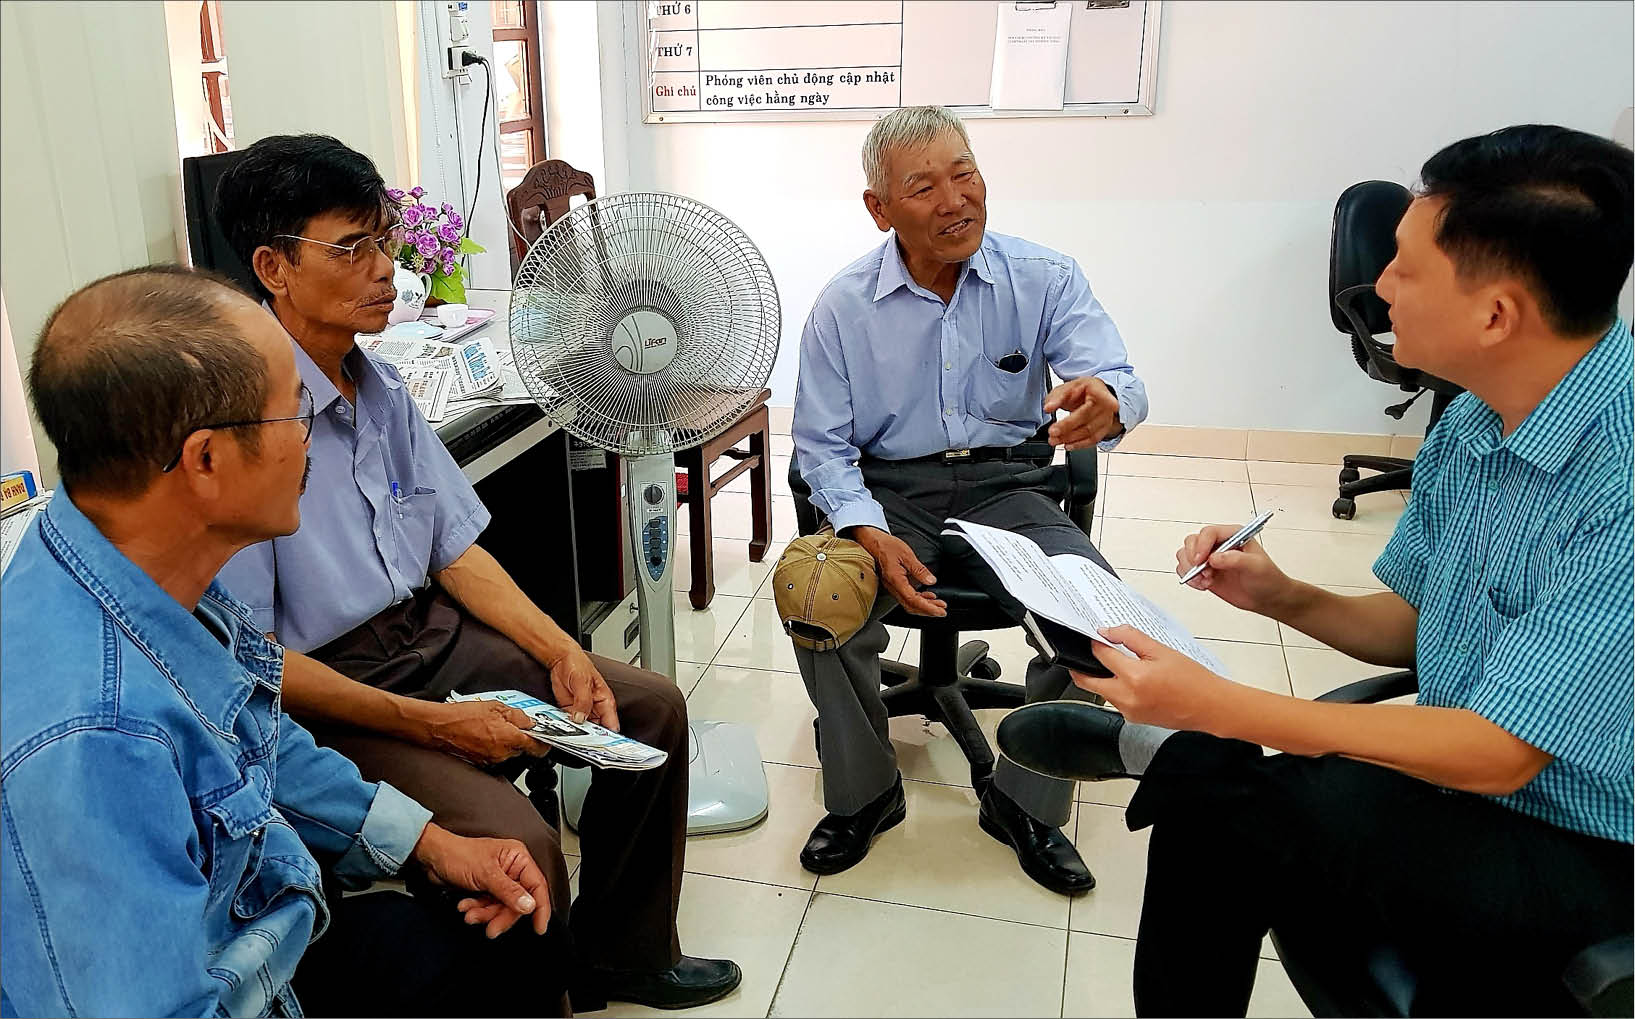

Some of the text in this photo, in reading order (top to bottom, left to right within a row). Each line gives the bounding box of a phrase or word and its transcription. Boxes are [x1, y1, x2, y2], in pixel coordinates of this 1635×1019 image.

[684, 4, 691, 15] 6
[656, 42, 693, 57] THỨ 7
[705, 74, 744, 89] Phóng
[747, 75, 773, 86] viên
[777, 73, 799, 85] chủ
[839, 72, 862, 86] cập
[865, 70, 896, 84] nhật
[655, 85, 674, 97] Ghi
[706, 89, 830, 108] công việc hằng ngày
